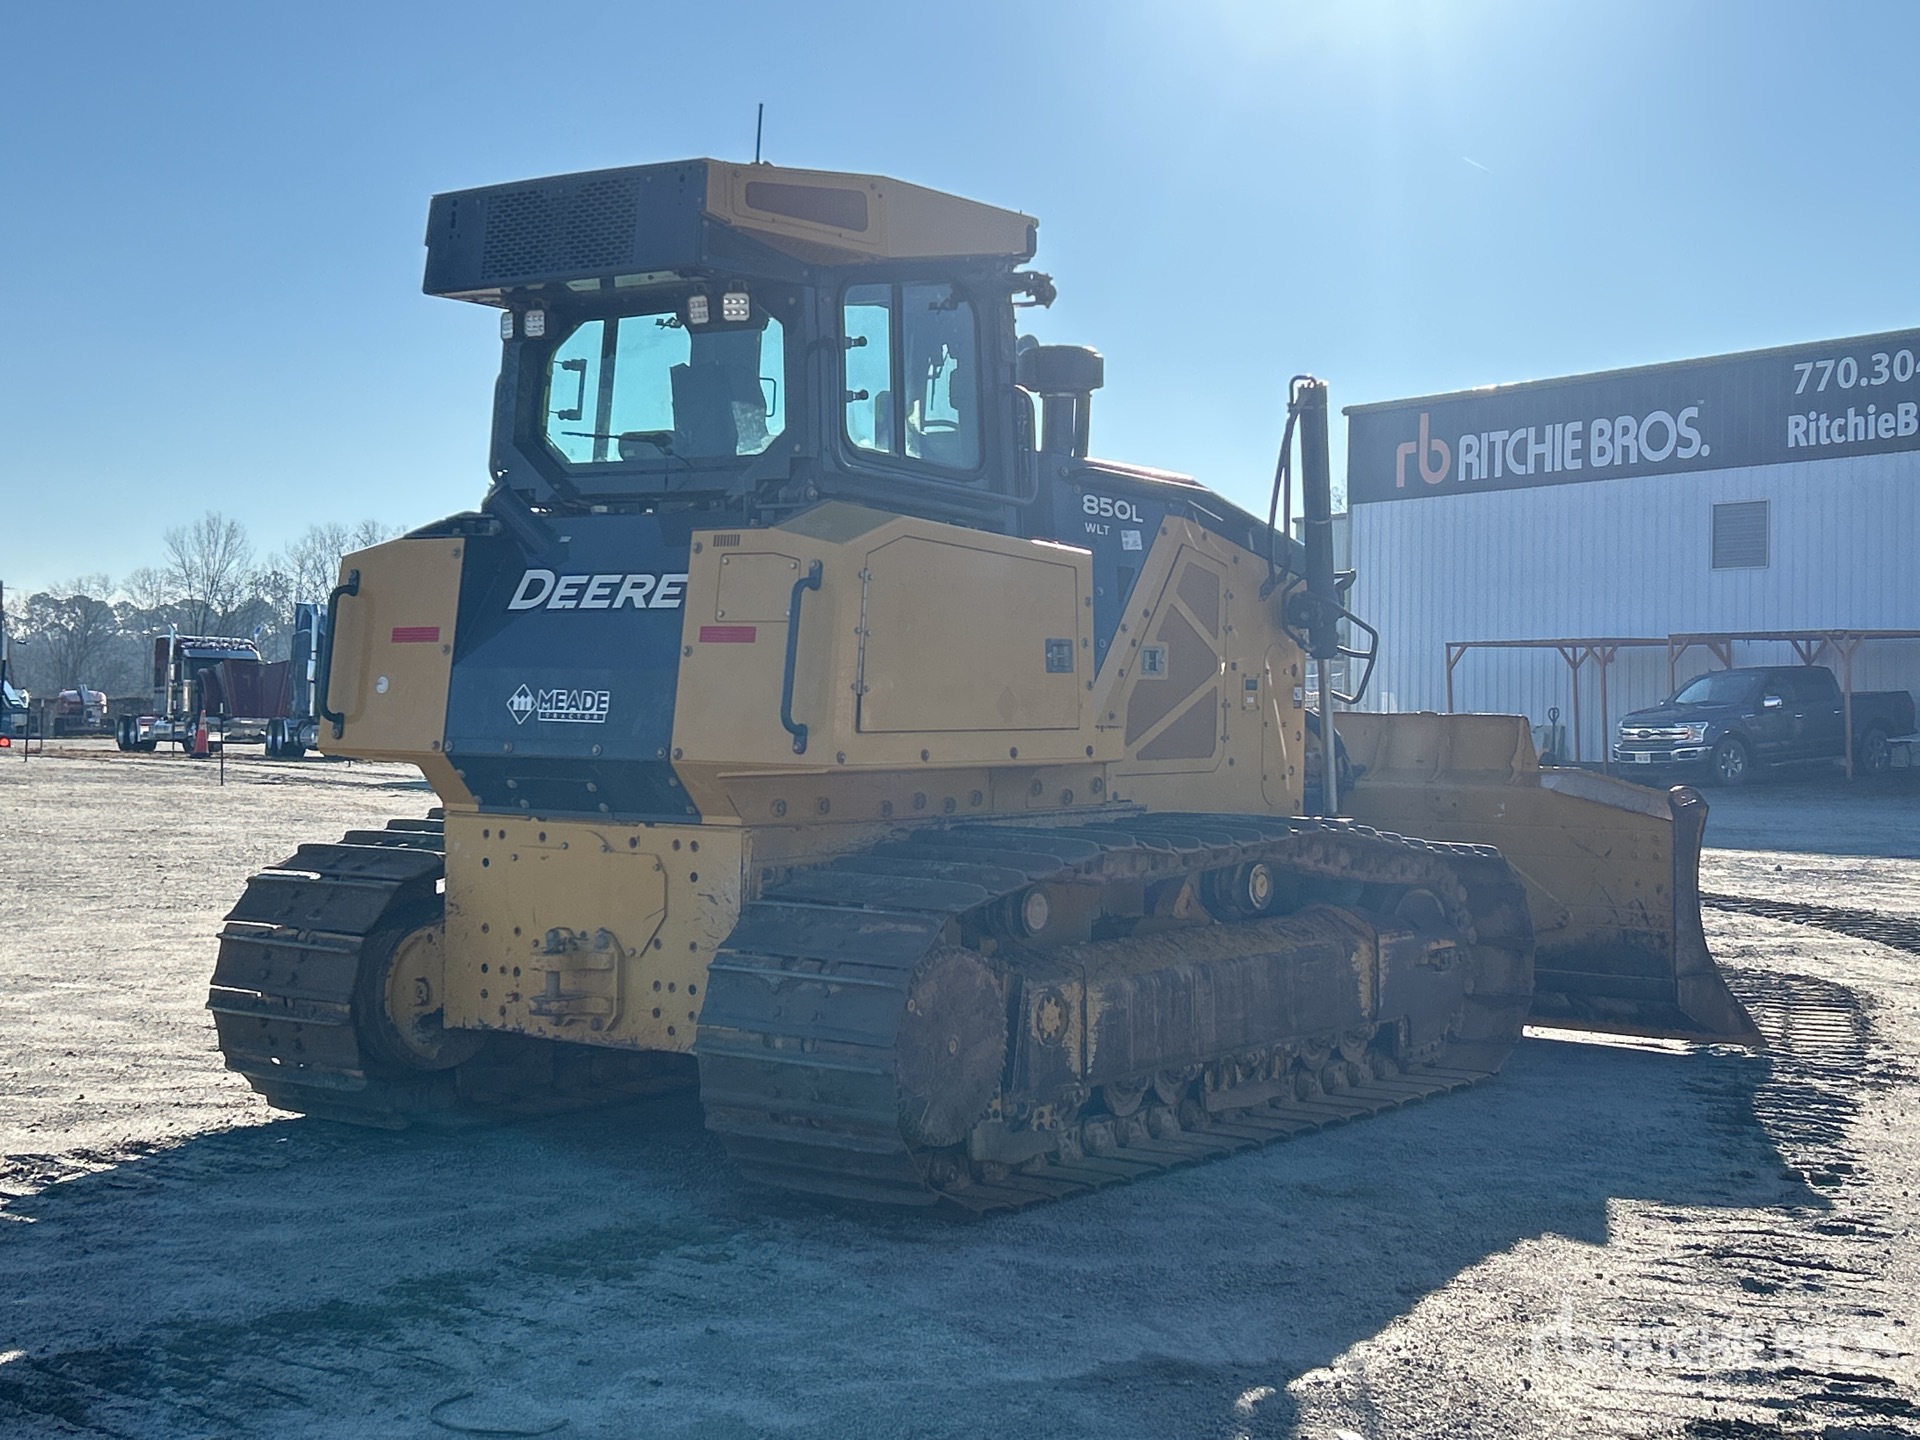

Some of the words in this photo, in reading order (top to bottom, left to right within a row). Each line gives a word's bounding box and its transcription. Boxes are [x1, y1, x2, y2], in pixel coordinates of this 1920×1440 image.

[1793, 349, 1920, 395] 770.30
[1457, 420, 1583, 482] RITCHIE
[1589, 406, 1711, 468] BROS.
[1082, 494, 1144, 523] 850L
[1084, 522, 1111, 536] WLT
[507, 568, 689, 610] DEERE
[537, 689, 610, 713] MEADE
[544, 712, 599, 720] TRACTOR
